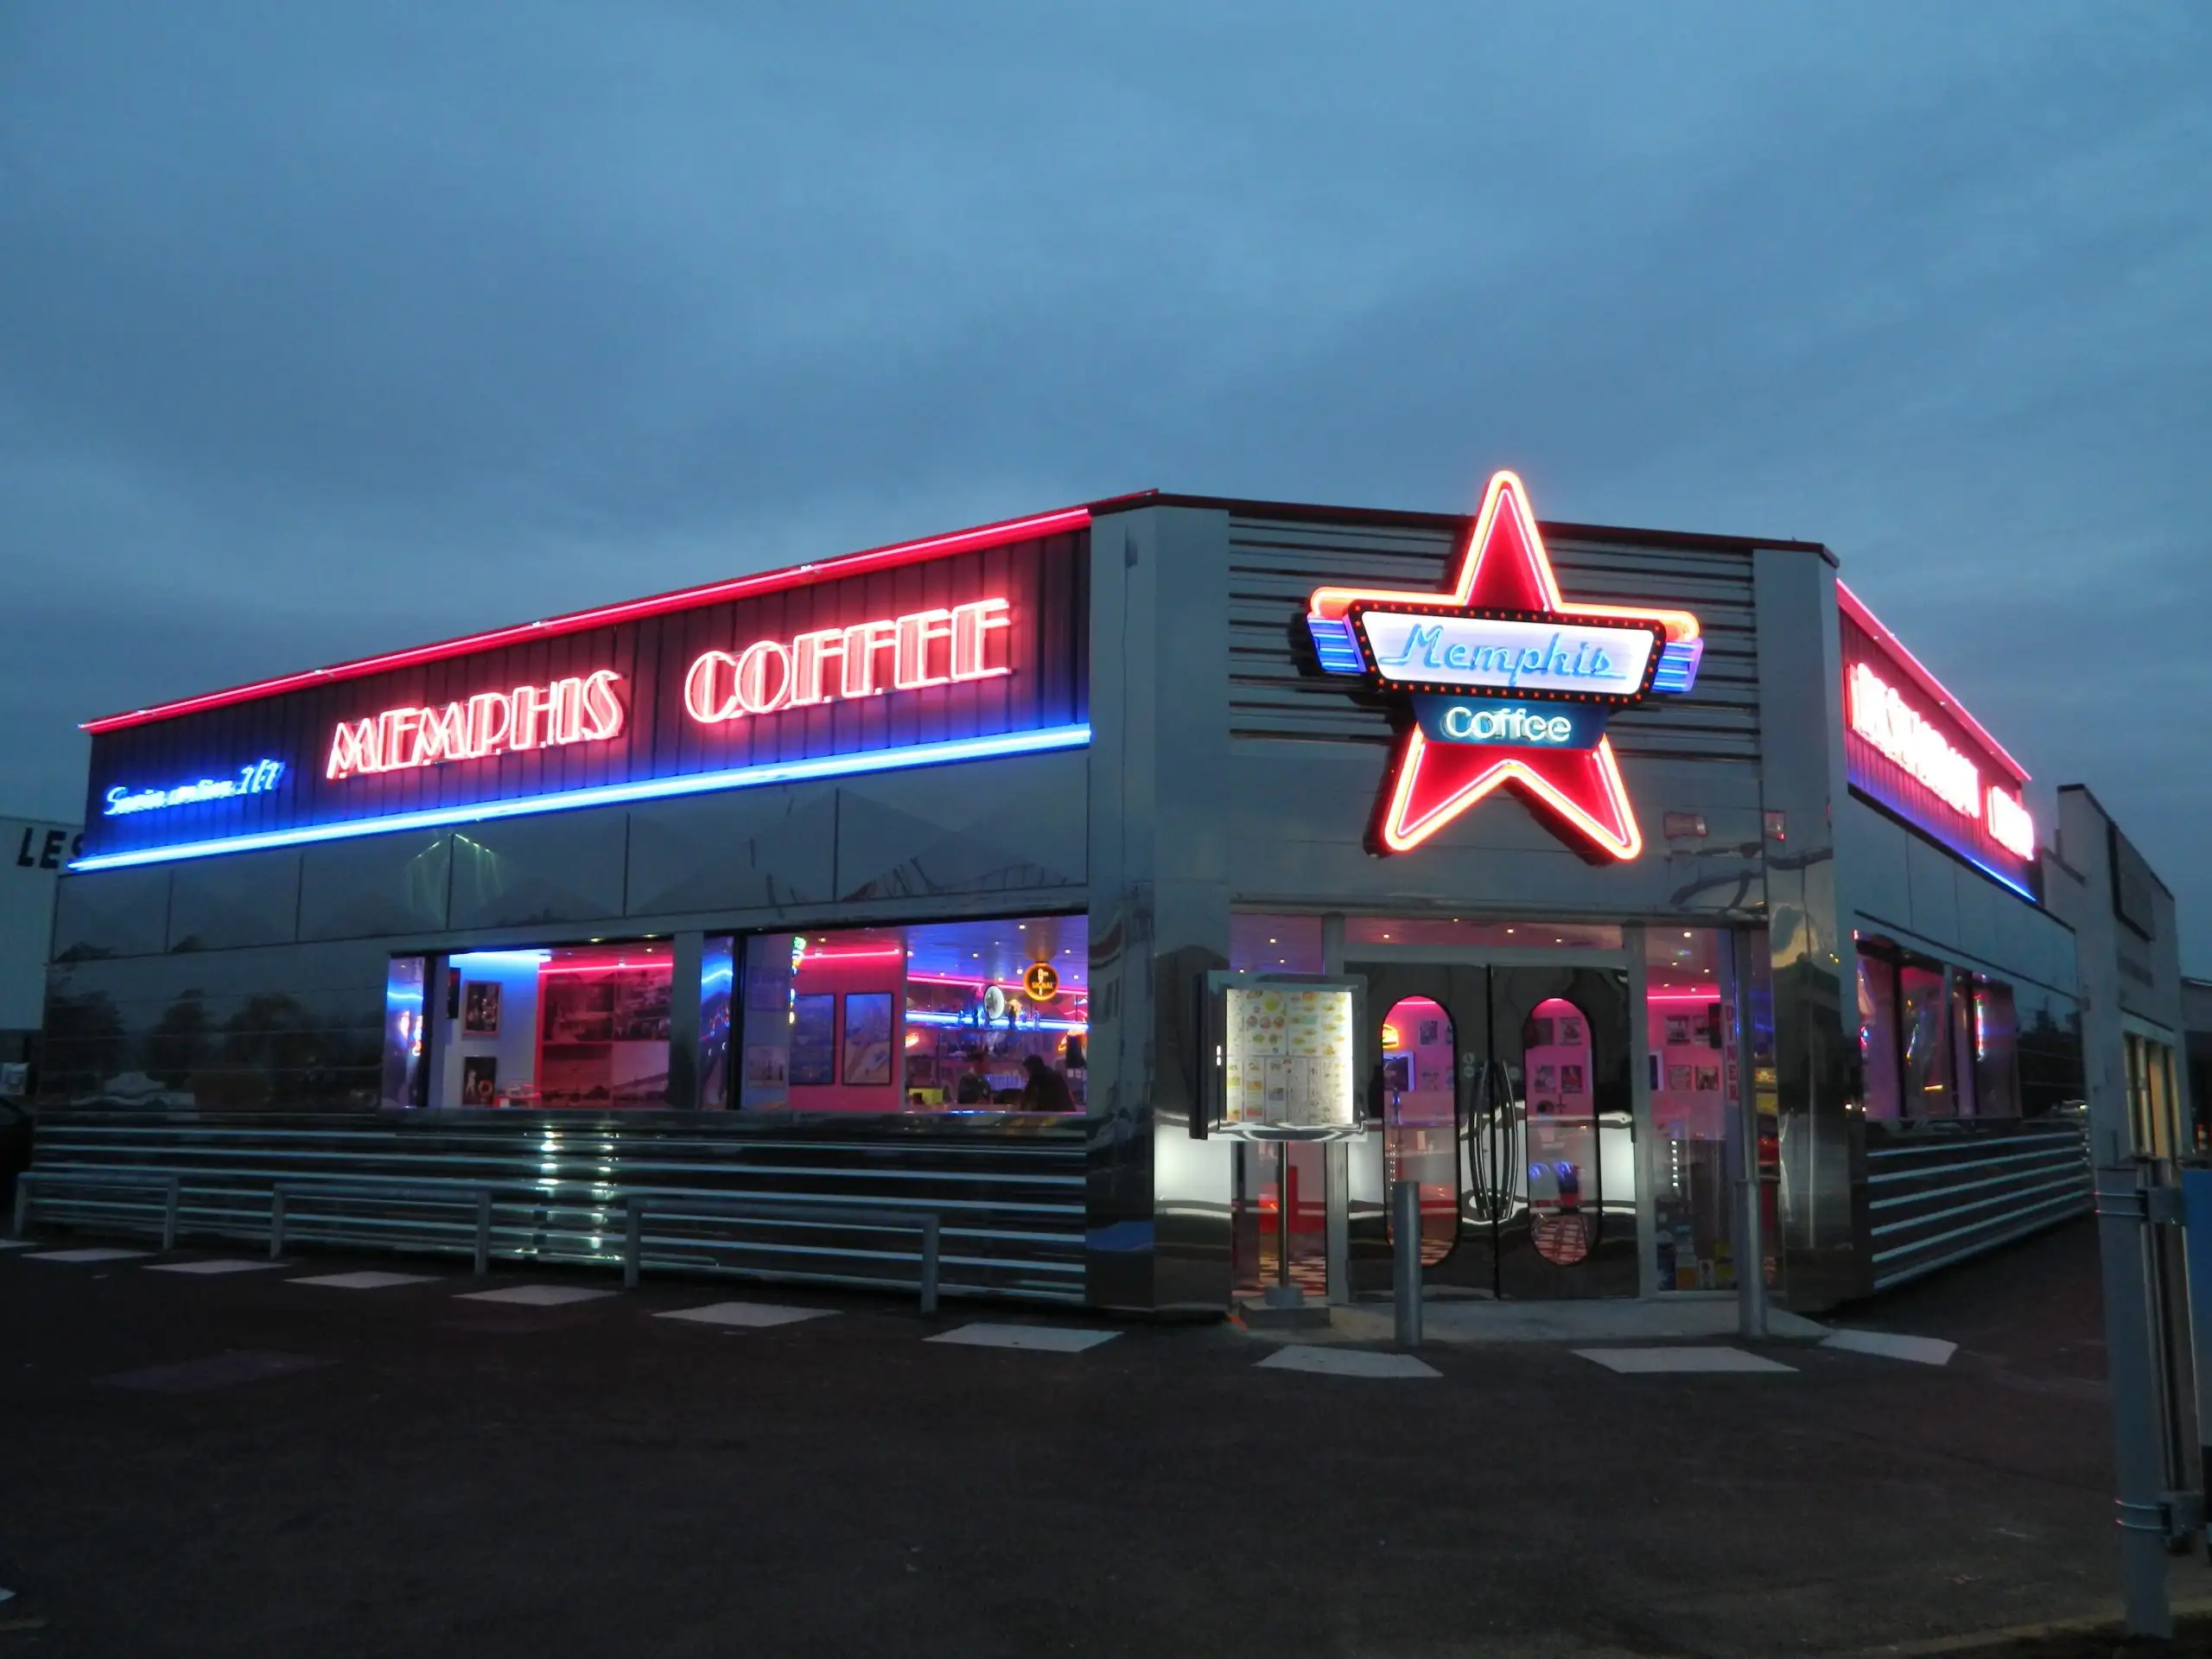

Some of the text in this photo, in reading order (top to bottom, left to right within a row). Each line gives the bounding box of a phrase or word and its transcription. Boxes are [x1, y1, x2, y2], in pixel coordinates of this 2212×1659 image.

[1378, 623, 1627, 686] Memphis
[326, 596, 1013, 780] MEMPHIS COFFEE
[1442, 706, 1572, 742] Coffee
